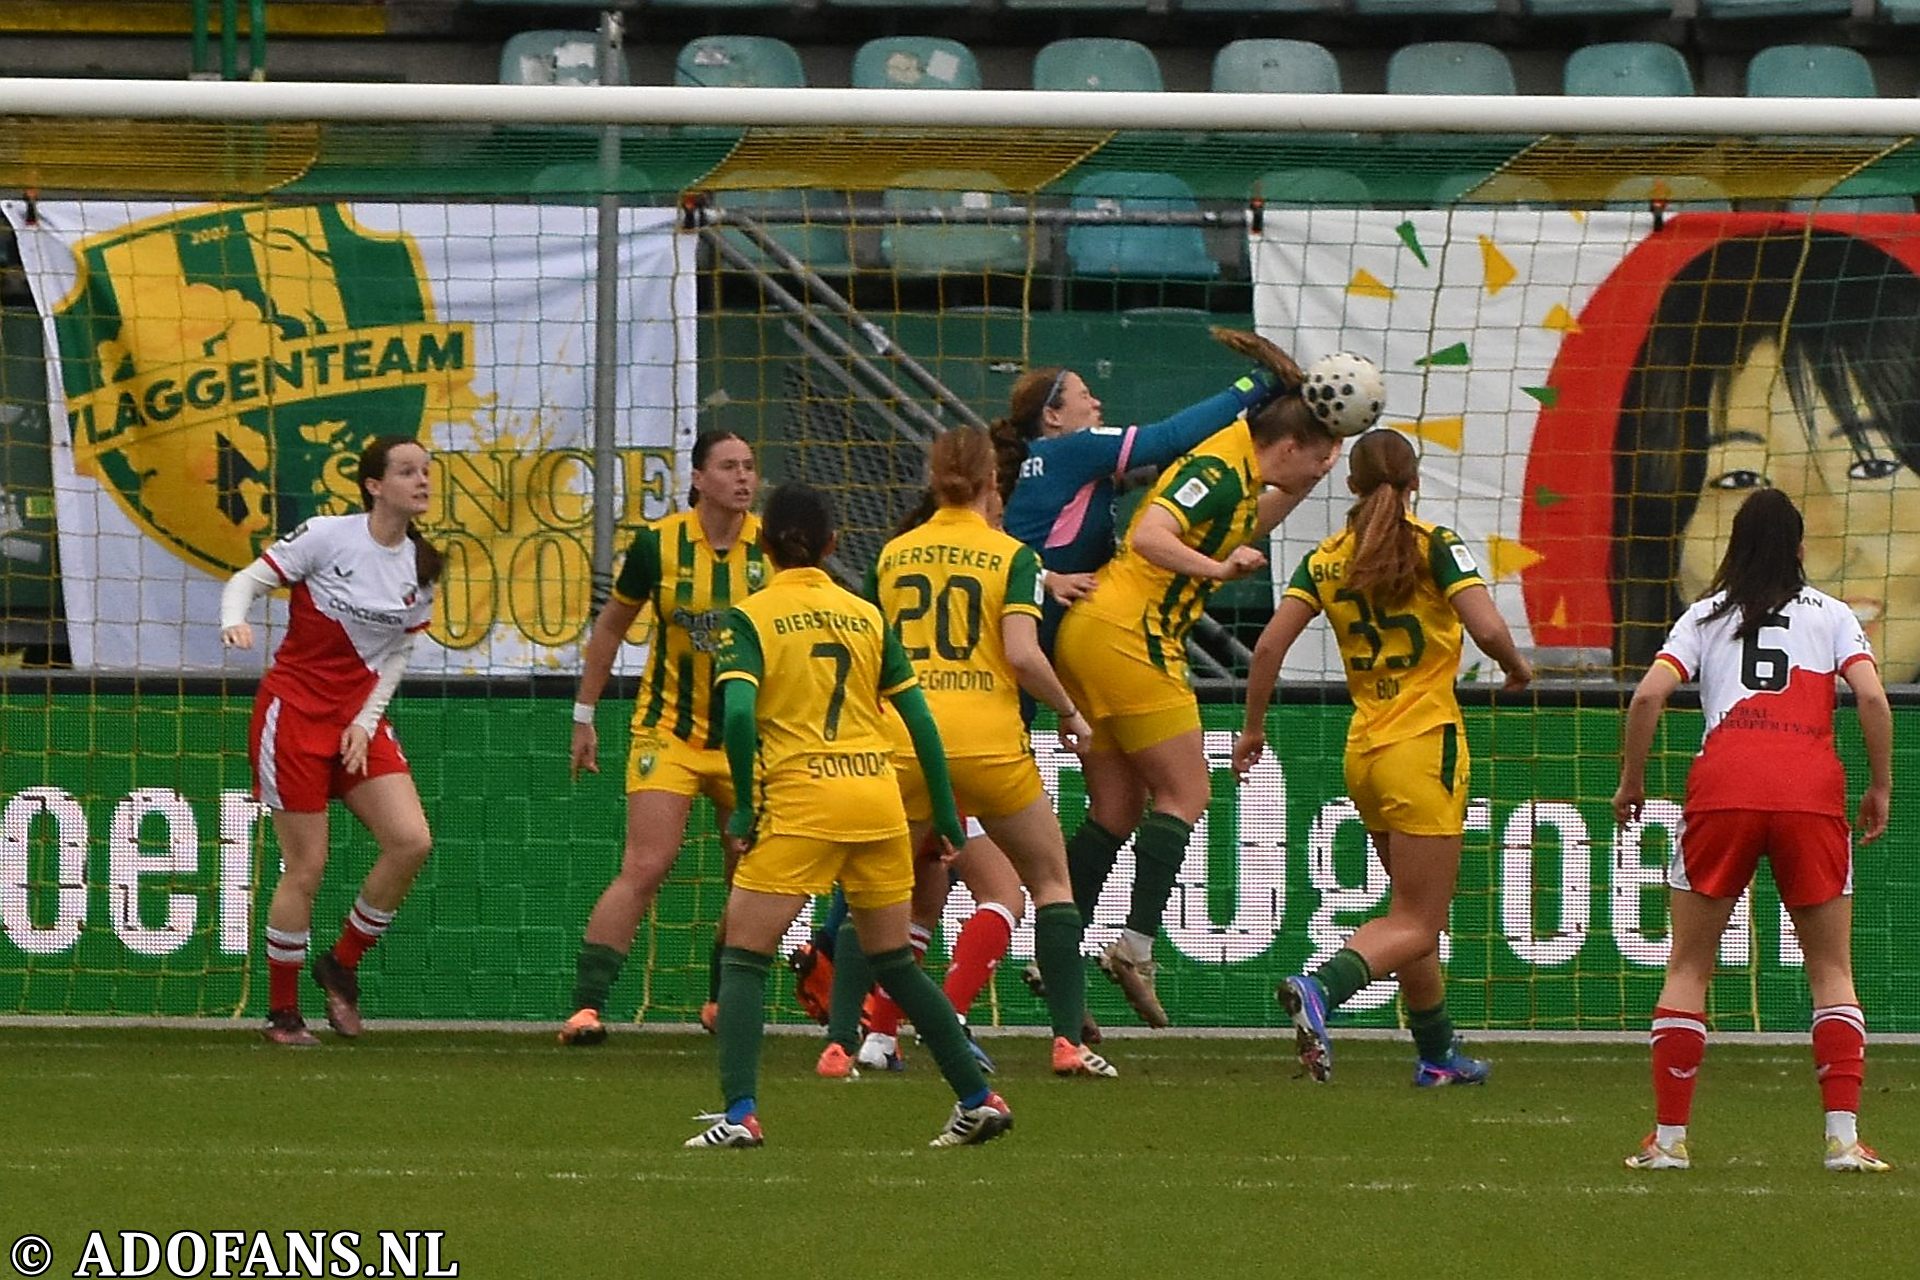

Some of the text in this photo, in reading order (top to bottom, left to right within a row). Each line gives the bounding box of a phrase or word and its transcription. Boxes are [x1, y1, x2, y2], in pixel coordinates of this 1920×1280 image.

[320, 448, 675, 533] SNCE
[893, 574, 982, 661] 20
[1334, 588, 1426, 671] 35
[1741, 614, 1791, 691] 6
[811, 642, 851, 742] 7
